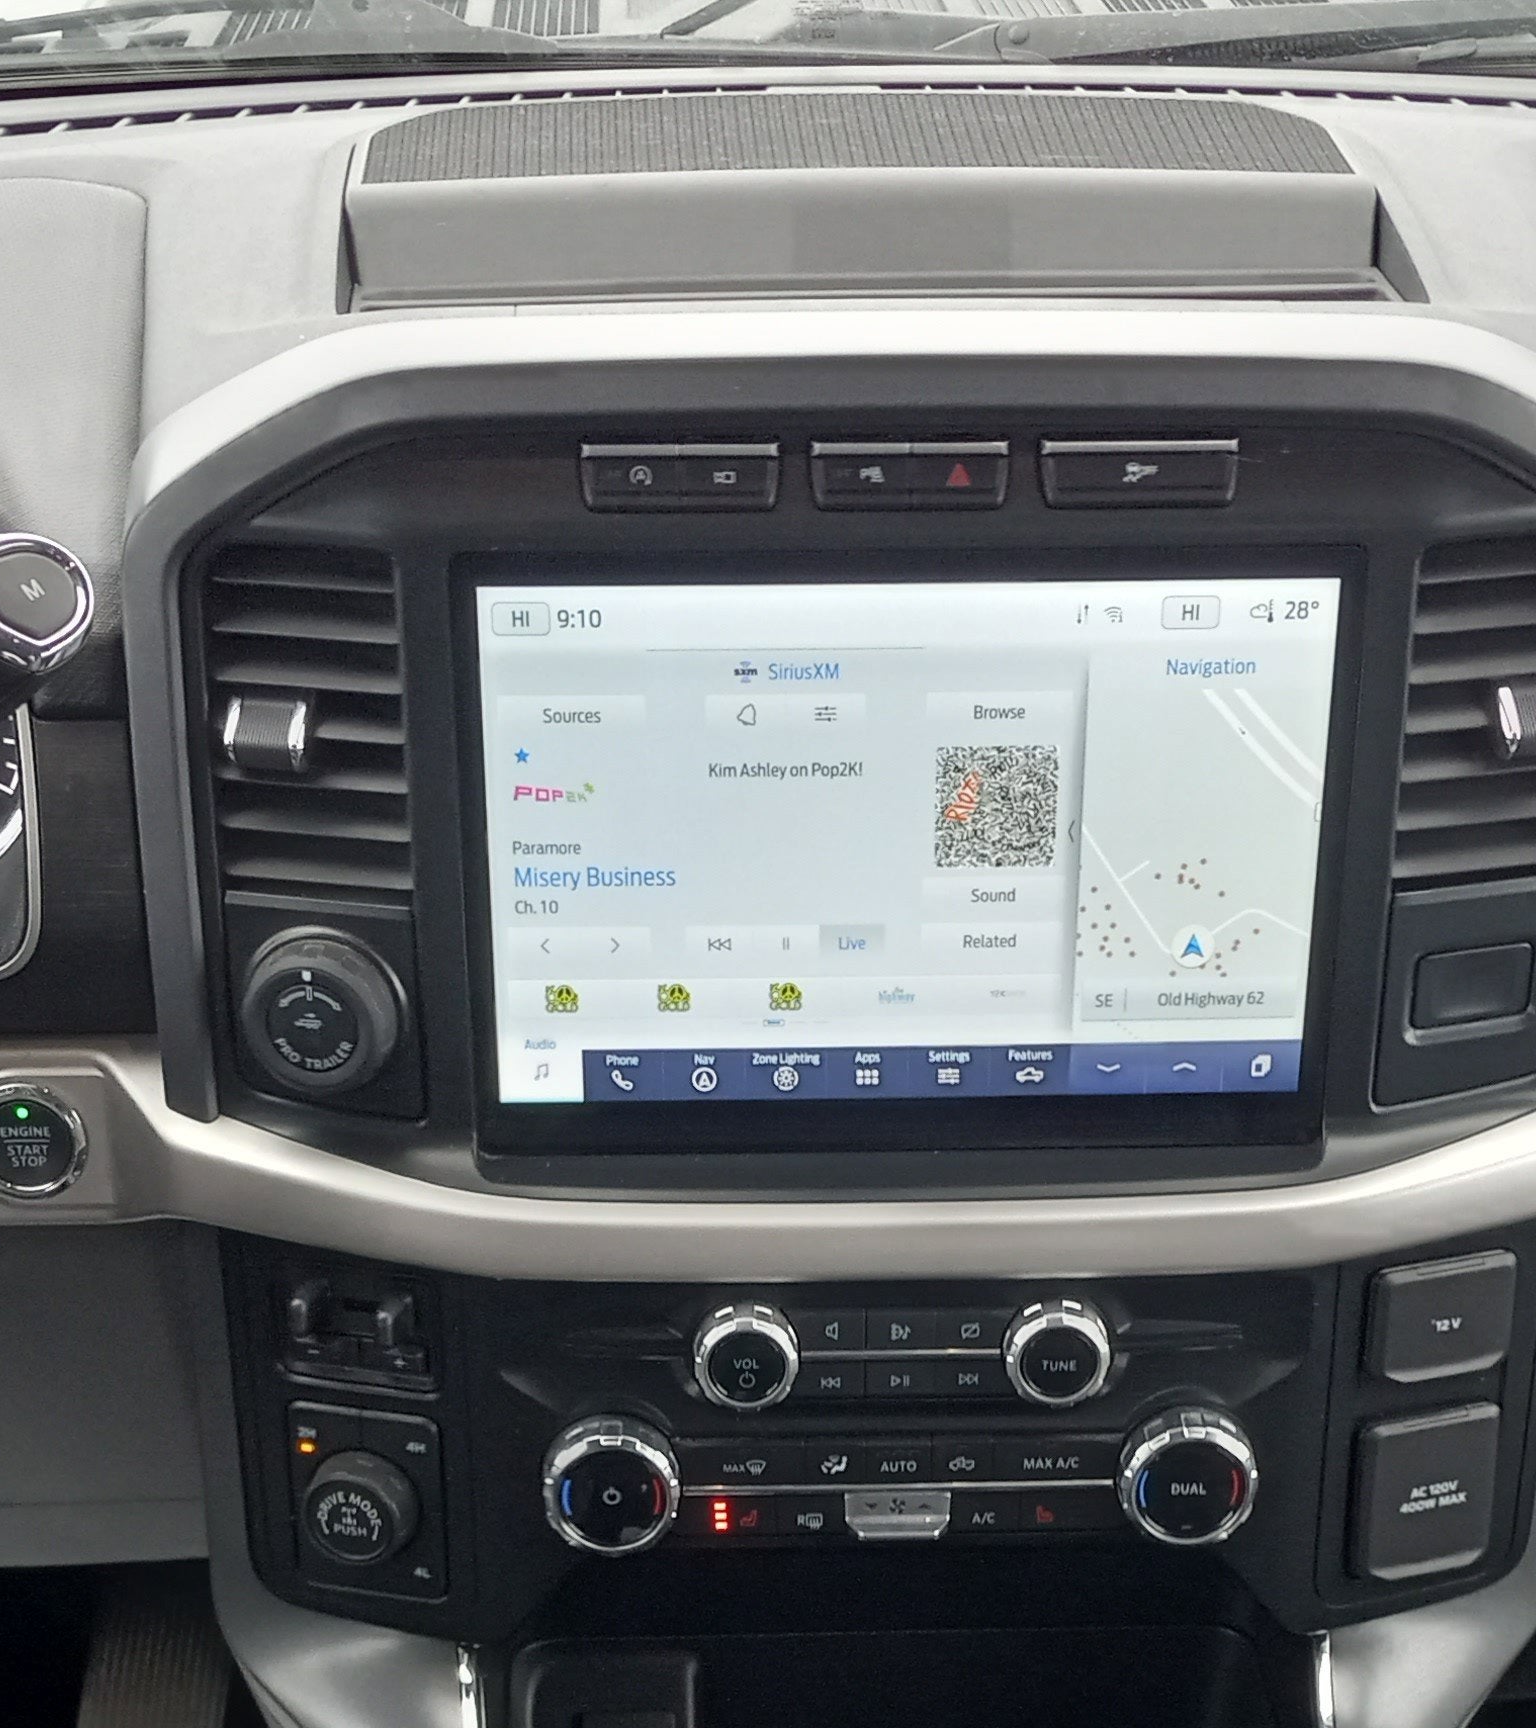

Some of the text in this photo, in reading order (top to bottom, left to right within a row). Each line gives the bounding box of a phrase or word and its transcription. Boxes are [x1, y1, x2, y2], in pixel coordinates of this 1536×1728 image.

[20, 578, 46, 602] M
[511, 609, 602, 629] HI 9:10
[1181, 604, 1200, 621] HI
[768, 662, 840, 680] SiriusXM
[1166, 658, 1256, 678] Navigation
[542, 708, 601, 724] Sources
[973, 705, 1026, 720] Browse
[708, 761, 863, 780] Kim Ashley on Pop2K!
[512, 840, 582, 856] Paramore
[514, 866, 676, 891] Misery Business
[970, 887, 1016, 903] Sound
[514, 899, 559, 915] Ch. 10
[838, 936, 866, 950] Live
[962, 933, 1017, 949] Related
[1094, 991, 1265, 1009] SE Old Highway 62
[524, 1038, 557, 1050] Audio
[274, 1037, 354, 1070] PRO TRAILER
[605, 1054, 640, 1067] Phone
[693, 1053, 716, 1066] Nav
[752, 1052, 821, 1066] Zone Lighting
[854, 1051, 881, 1065] Apps
[928, 1049, 971, 1064] Settings
[1008, 1049, 1054, 1062] Features
[0, 1126, 52, 1138] ENGINE
[6, 1144, 49, 1157] START
[11, 1156, 48, 1168] STOP
[733, 1358, 760, 1371] VOL
[1041, 1359, 1078, 1372] TUNE
[722, 1463, 746, 1474] MAX
[880, 1460, 918, 1474] AUTO
[1023, 1456, 1081, 1470] MAX A/C
[1170, 1482, 1207, 1496] DUAL
[1438, 1491, 1468, 1508] MAX
[317, 1491, 383, 1527] DRIVE MODE
[971, 1512, 996, 1525] A/C
[333, 1522, 368, 1538] PUSH
